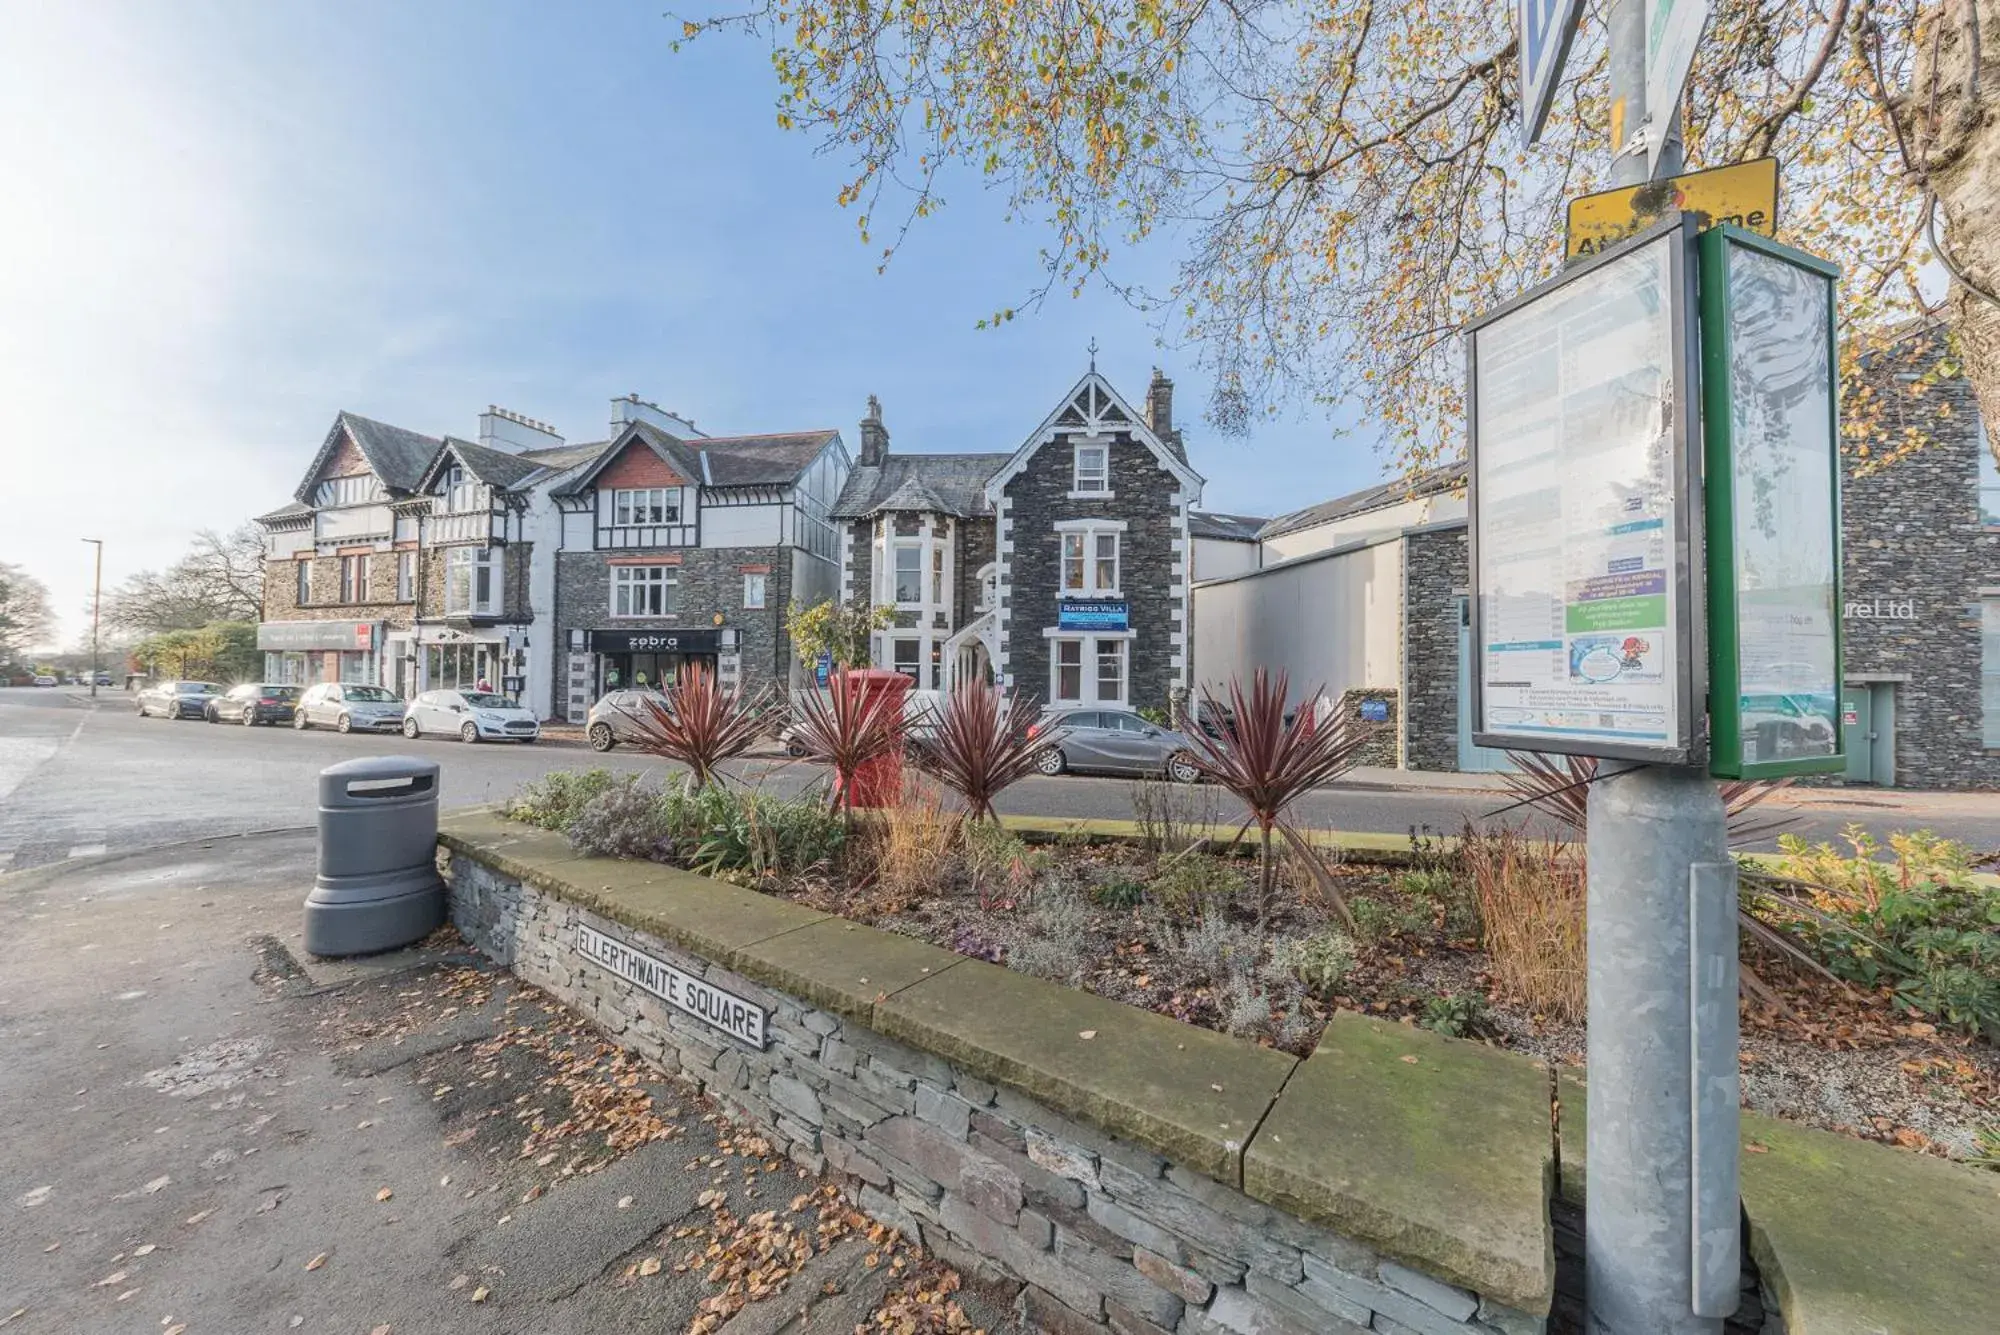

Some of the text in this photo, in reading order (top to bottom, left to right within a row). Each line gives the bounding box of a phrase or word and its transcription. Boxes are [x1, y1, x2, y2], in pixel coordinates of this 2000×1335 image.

[1100, 604, 1122, 612] VILLA
[1874, 599, 1920, 620] Ltd.
[629, 635, 678, 646] zebra
[579, 929, 760, 1041] ELLERTHWAITE SQUARE
